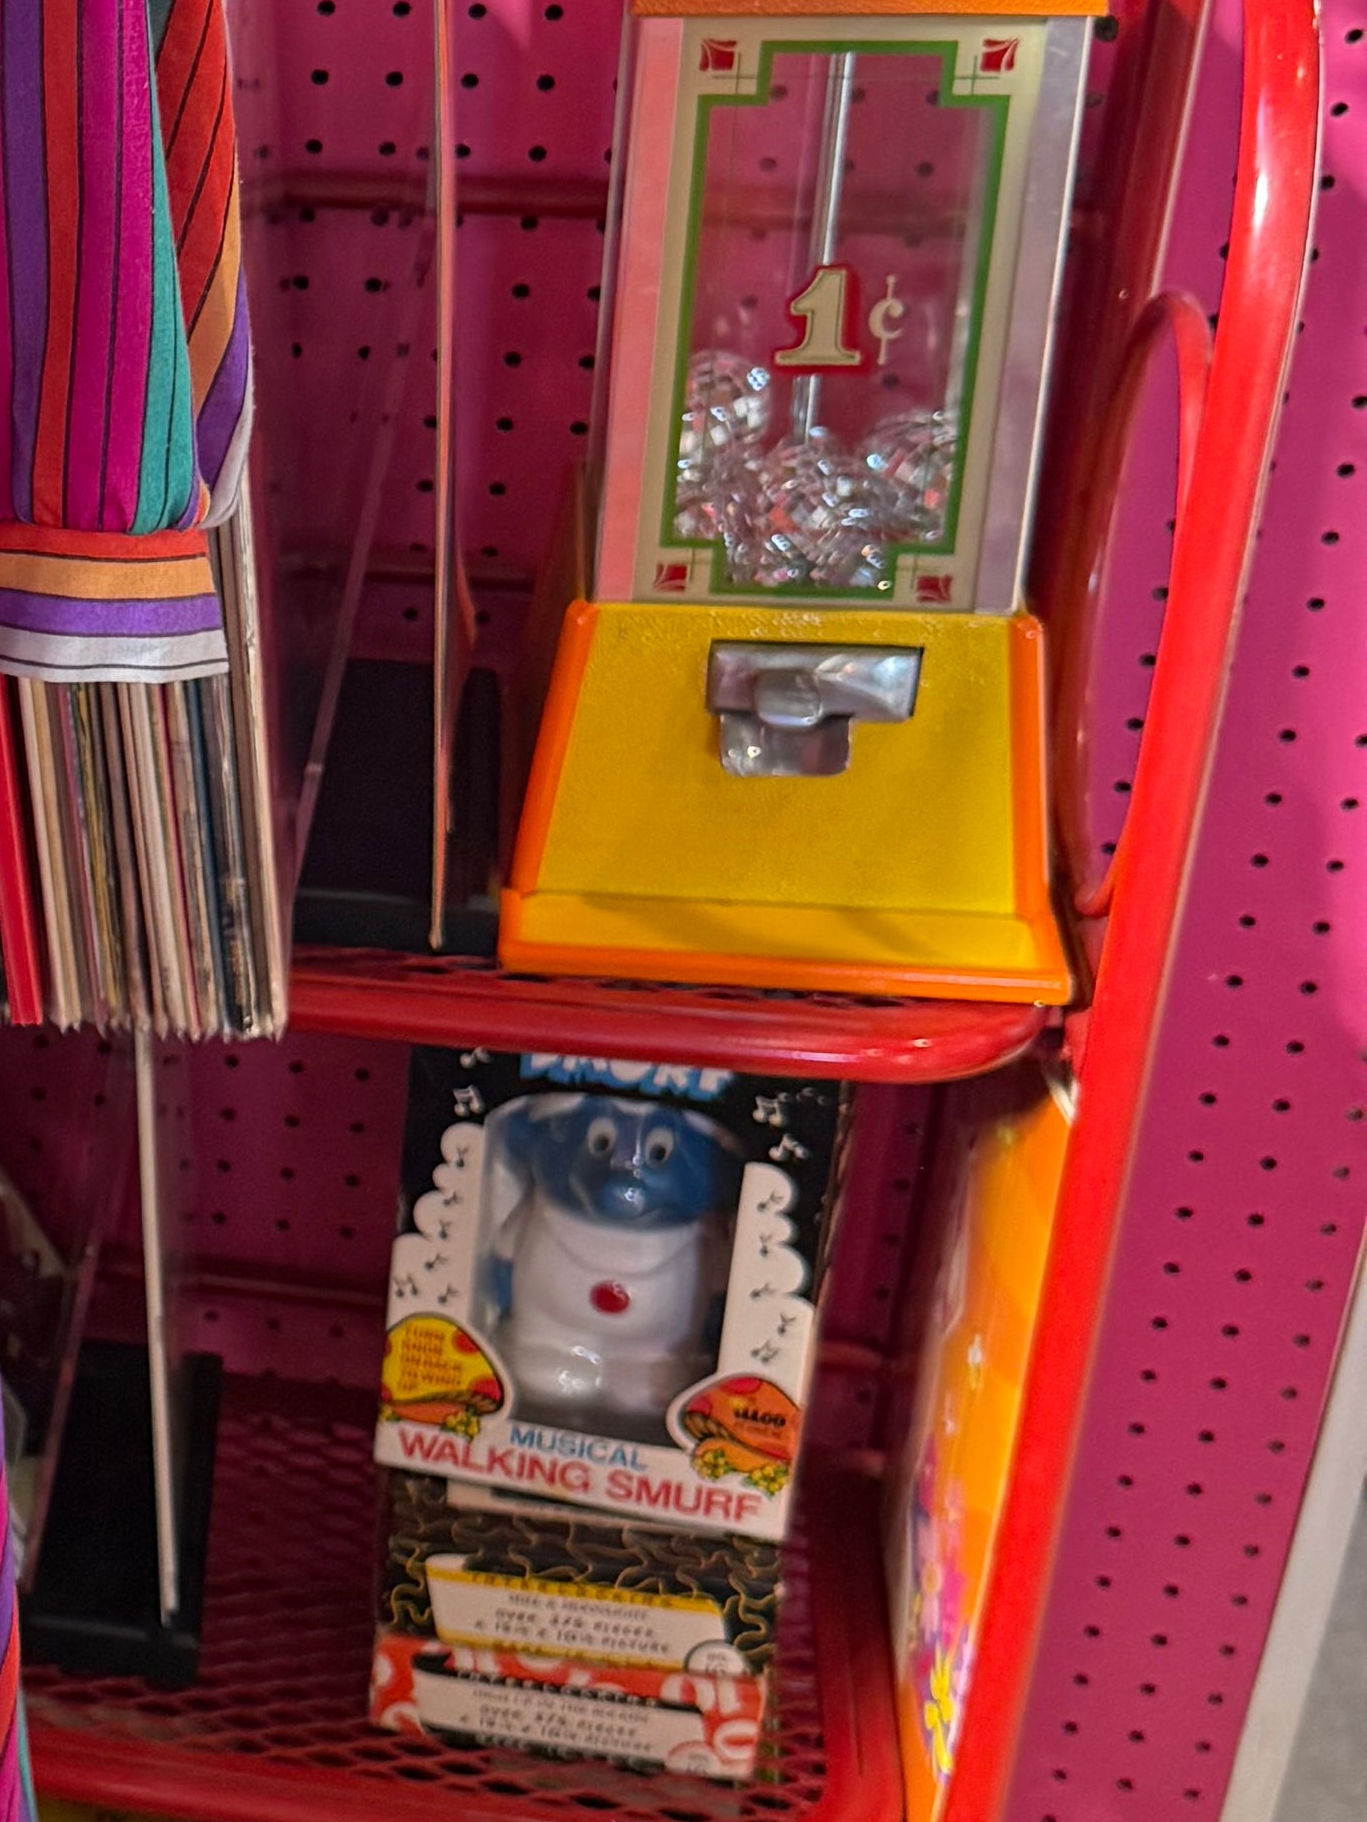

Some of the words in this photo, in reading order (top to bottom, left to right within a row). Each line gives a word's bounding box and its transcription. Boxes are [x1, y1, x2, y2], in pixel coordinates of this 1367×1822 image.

[397, 1426, 591, 1493] WALKING
[605, 1469, 763, 1523] SMURF
[509, 1424, 649, 1471] MUSICAL
